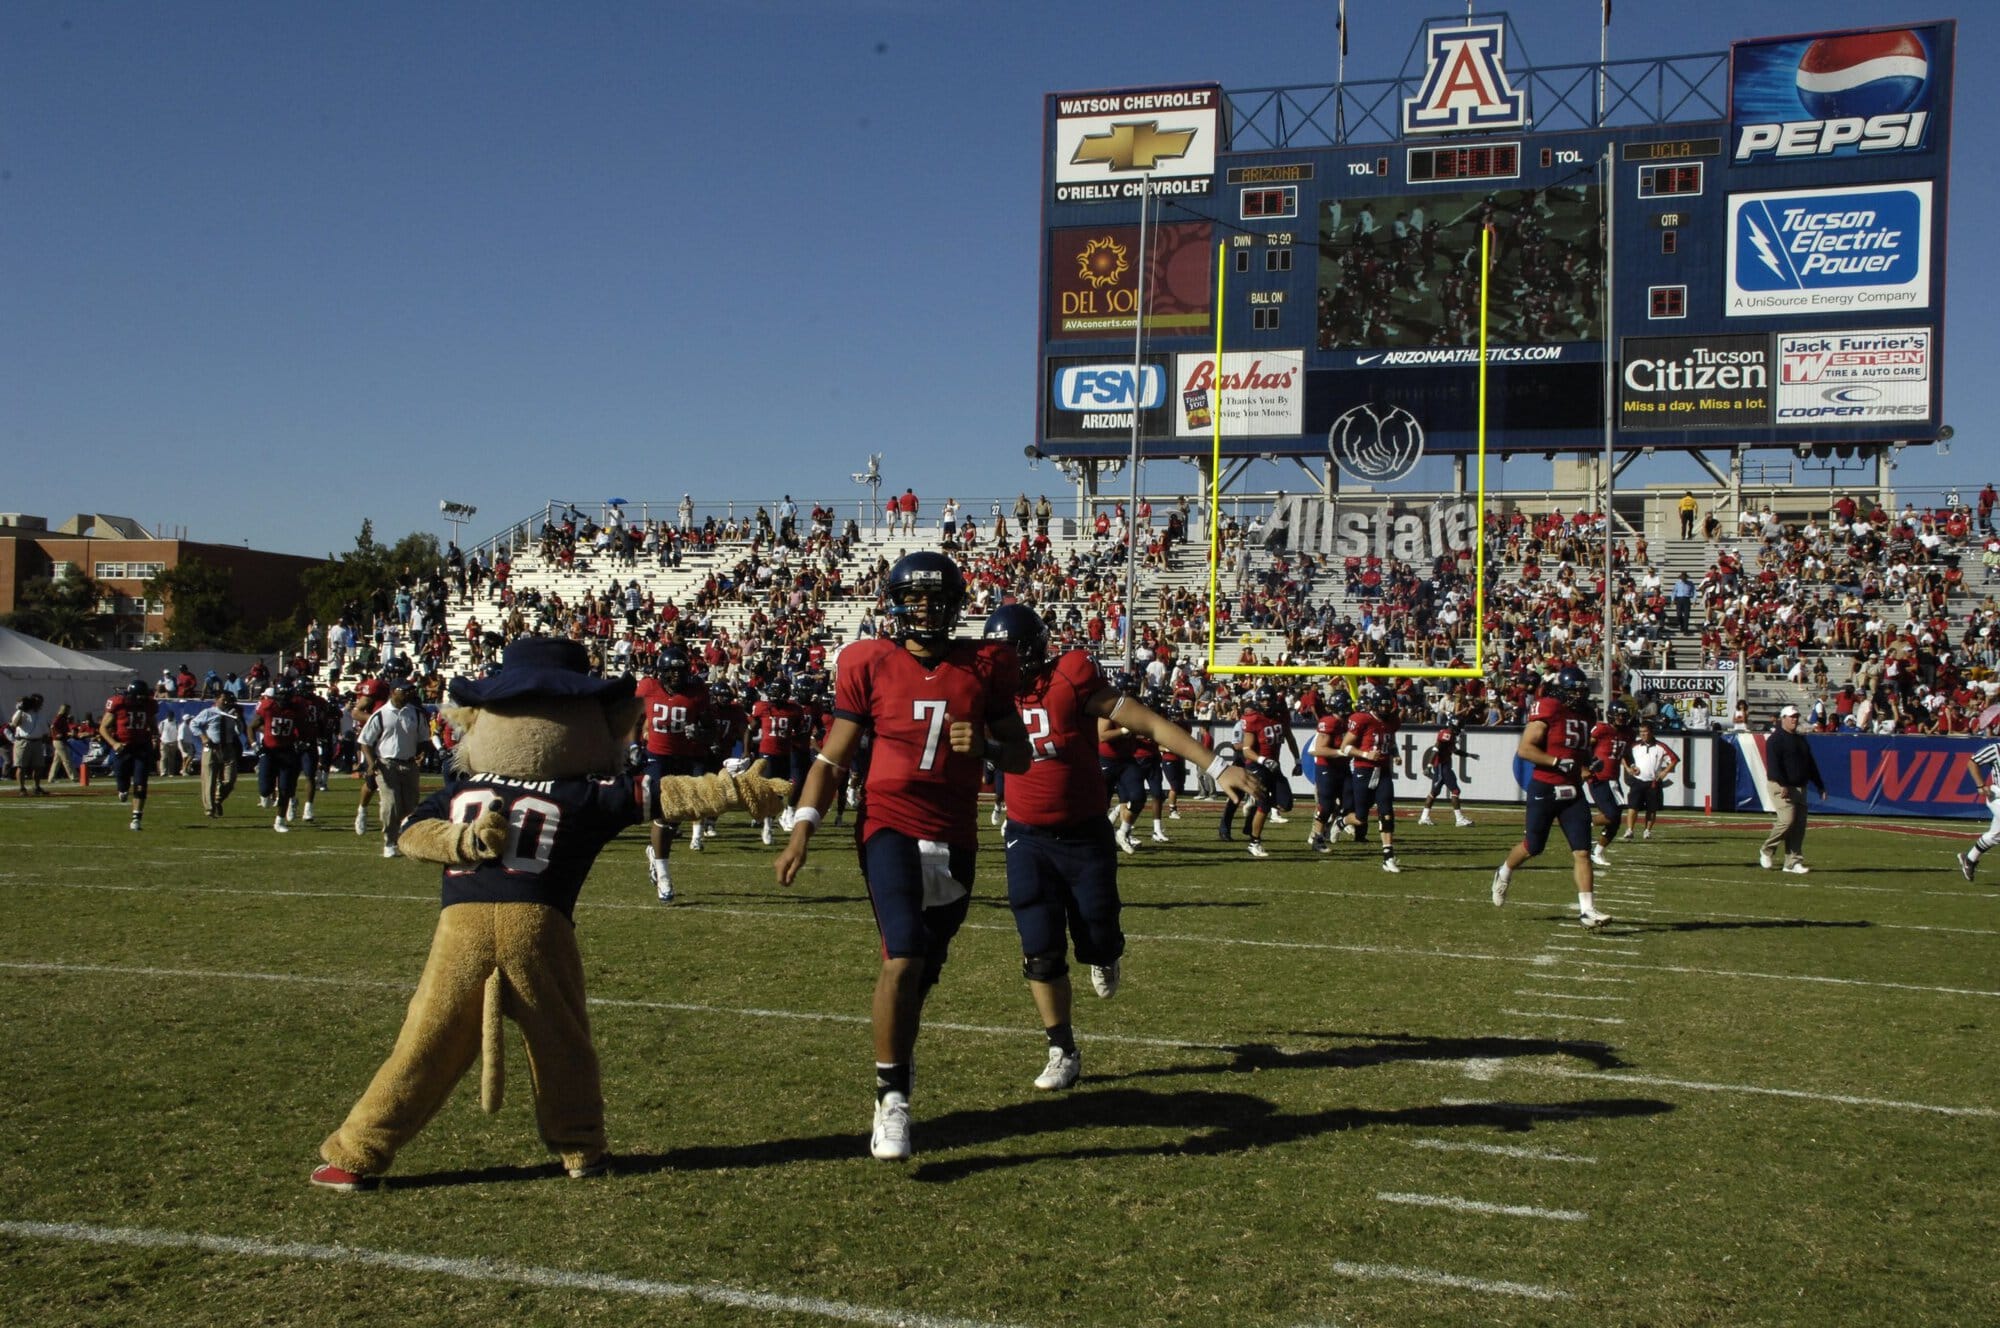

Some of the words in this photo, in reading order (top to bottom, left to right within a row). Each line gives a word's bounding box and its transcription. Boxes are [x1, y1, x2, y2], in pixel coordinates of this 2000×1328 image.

[1403, 24, 1524, 134] A
[1060, 98, 1120, 115] WATSON
[1123, 91, 1211, 110] CHEVROLET
[1735, 111, 1927, 160] PEPSI
[1555, 151, 1583, 163] TOL
[1650, 142, 1690, 158] UCLA
[1241, 166, 1300, 182] ARIZONA
[1348, 163, 1374, 175] TOL
[1057, 183, 1121, 200] O'RIELLY
[1661, 214, 1678, 227] QTR
[1781, 207, 1876, 232] Tucson
[1234, 235, 1251, 247] DWN
[1268, 233, 1277, 245] TO
[1790, 227, 1901, 254] Electric
[1800, 252, 1900, 276] Power
[1062, 291, 1096, 314] DEL
[1106, 288, 1138, 312] SOL
[1251, 293, 1269, 304] BALL
[1271, 292, 1283, 303] ON
[1734, 299, 1744, 309] A
[1747, 295, 1808, 309] UniSource
[1811, 292, 1854, 307] Energy
[1857, 290, 1917, 305] Company
[1784, 338, 1831, 353] Jack
[1839, 336, 1924, 350] Furrier's
[1693, 348, 1764, 365] Tucson
[1624, 356, 1767, 392] Citizen
[1783, 350, 1925, 382] WESTERN
[1825, 369, 1848, 377] TIRE
[1851, 369, 1858, 377] &
[1862, 368, 1890, 377] AUTO
[1893, 368, 1921, 376] CARE
[1183, 360, 1297, 391] Bashas'
[1071, 370, 1148, 404] FSN
[1226, 397, 1257, 405] Thanks
[1260, 396, 1275, 405] You
[1278, 395, 1288, 406] By
[1624, 400, 1654, 412] Miss
[1657, 402, 1666, 411] a
[1669, 399, 1695, 413] day.
[1700, 398, 1731, 411] Miss
[1734, 401, 1742, 410] a
[1745, 397, 1766, 410] lot.
[1082, 413, 1135, 429] ARIZONA
[1243, 409, 1258, 417] You
[1946, 494, 1958, 505] 29
[1260, 496, 1478, 560] Allstate
[1718, 660, 1735, 670] 29
[1643, 677, 1724, 693] BRUEGGER'S
[652, 703, 687, 734] 28
[913, 700, 948, 771] 7
[1263, 724, 1283, 745] 92
[1565, 719, 1588, 750] 51
[1850, 749, 1993, 804] WIL
